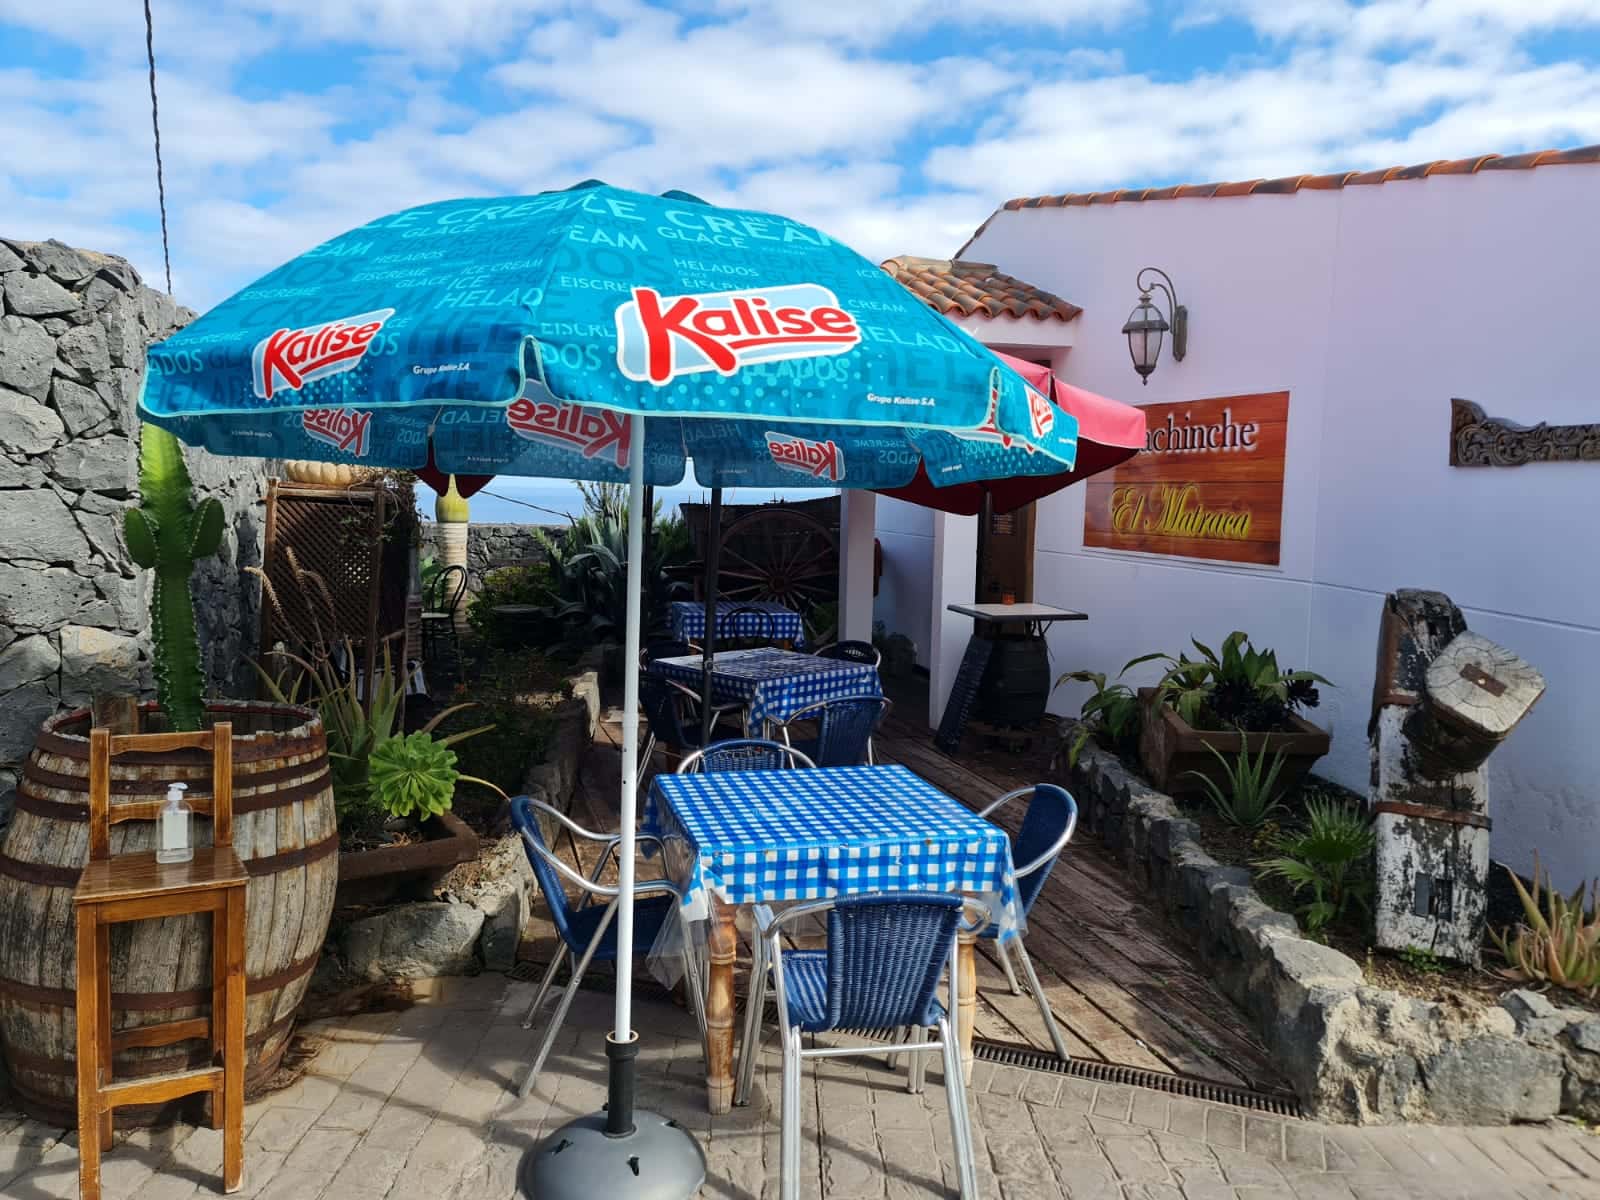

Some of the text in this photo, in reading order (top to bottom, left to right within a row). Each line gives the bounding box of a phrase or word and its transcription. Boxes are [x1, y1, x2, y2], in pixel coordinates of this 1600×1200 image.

[401, 223, 482, 238] GLACE
[657, 226, 750, 249] GLACE
[673, 257, 760, 277] HELADOS
[448, 275, 490, 291] ICE
[848, 299, 908, 313] CREAM
[633, 287, 859, 383] Kalise
[262, 320, 384, 401] Kalise
[866, 393, 892, 404] Grupo
